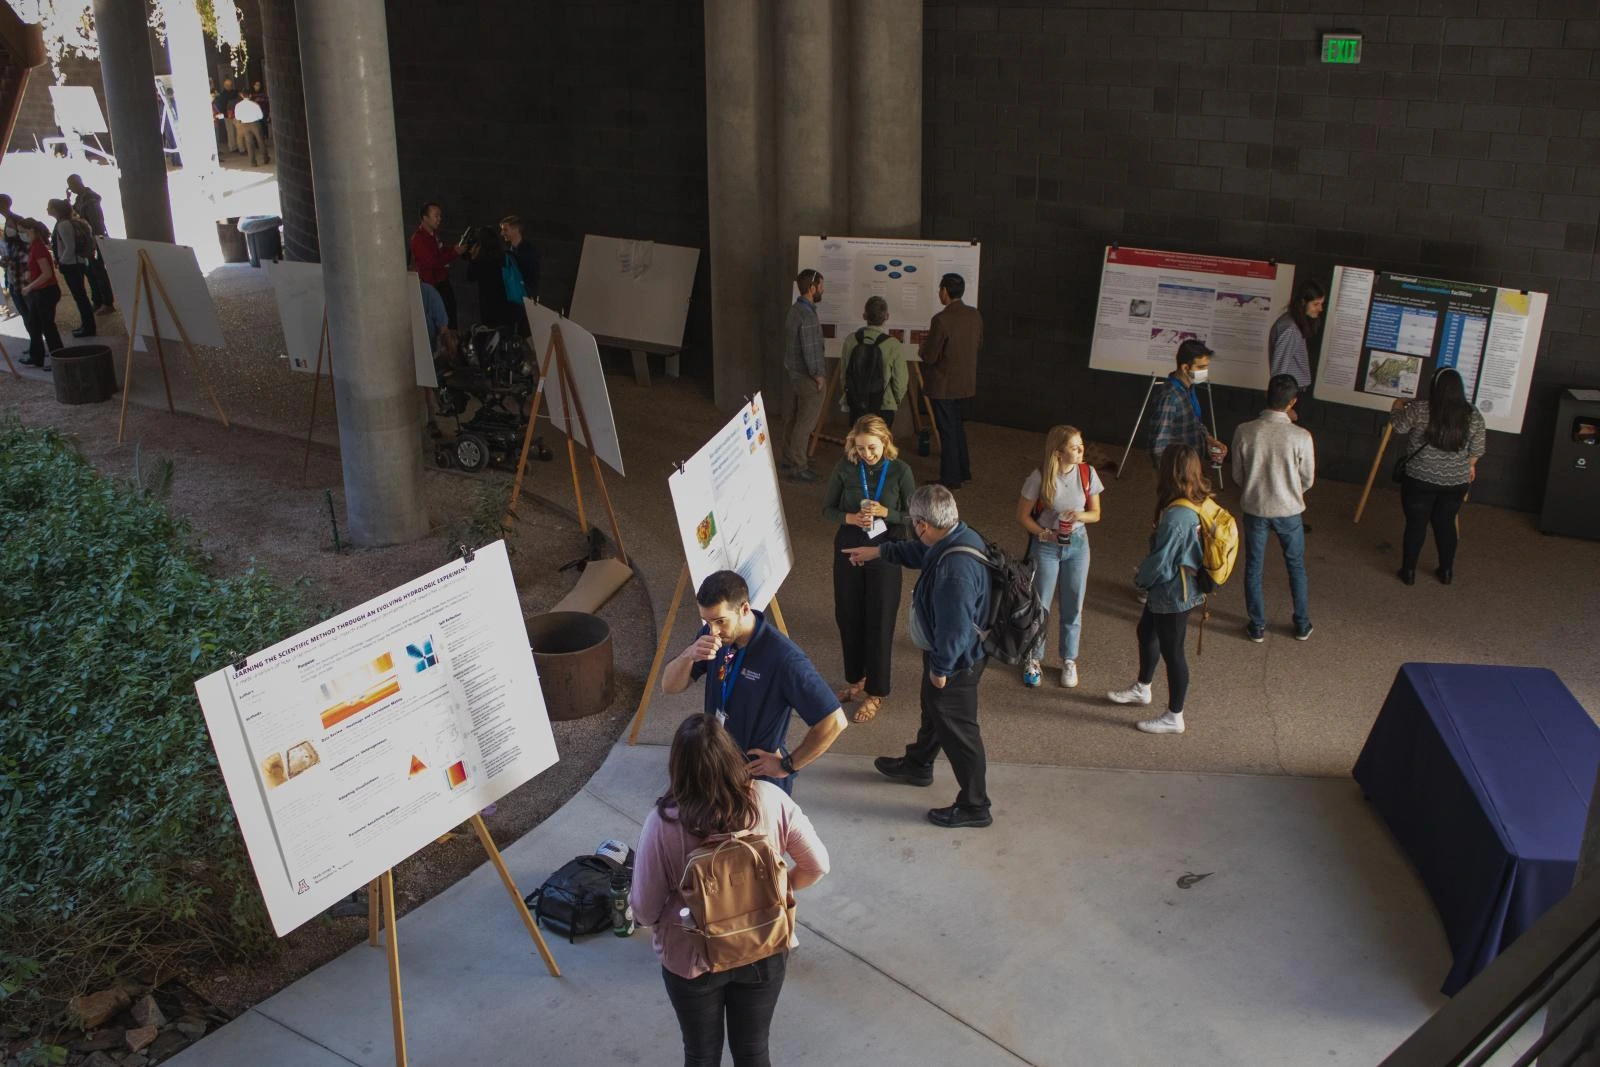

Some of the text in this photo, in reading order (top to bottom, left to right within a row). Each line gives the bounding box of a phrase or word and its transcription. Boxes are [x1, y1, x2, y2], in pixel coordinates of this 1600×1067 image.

[1327, 39, 1357, 64] EXIT
[232, 661, 264, 680] LEARNING
[265, 655, 278, 665] THE
[278, 639, 309, 659] SCIENTIFIC
[310, 627, 336, 643] METHOD
[337, 613, 366, 631] THROUGH
[367, 609, 376, 618] AN
[376, 596, 403, 613] EVOLVING
[403, 580, 437, 600] HYDROLOGIC
[437, 565, 468, 584] EXPERIMENT
